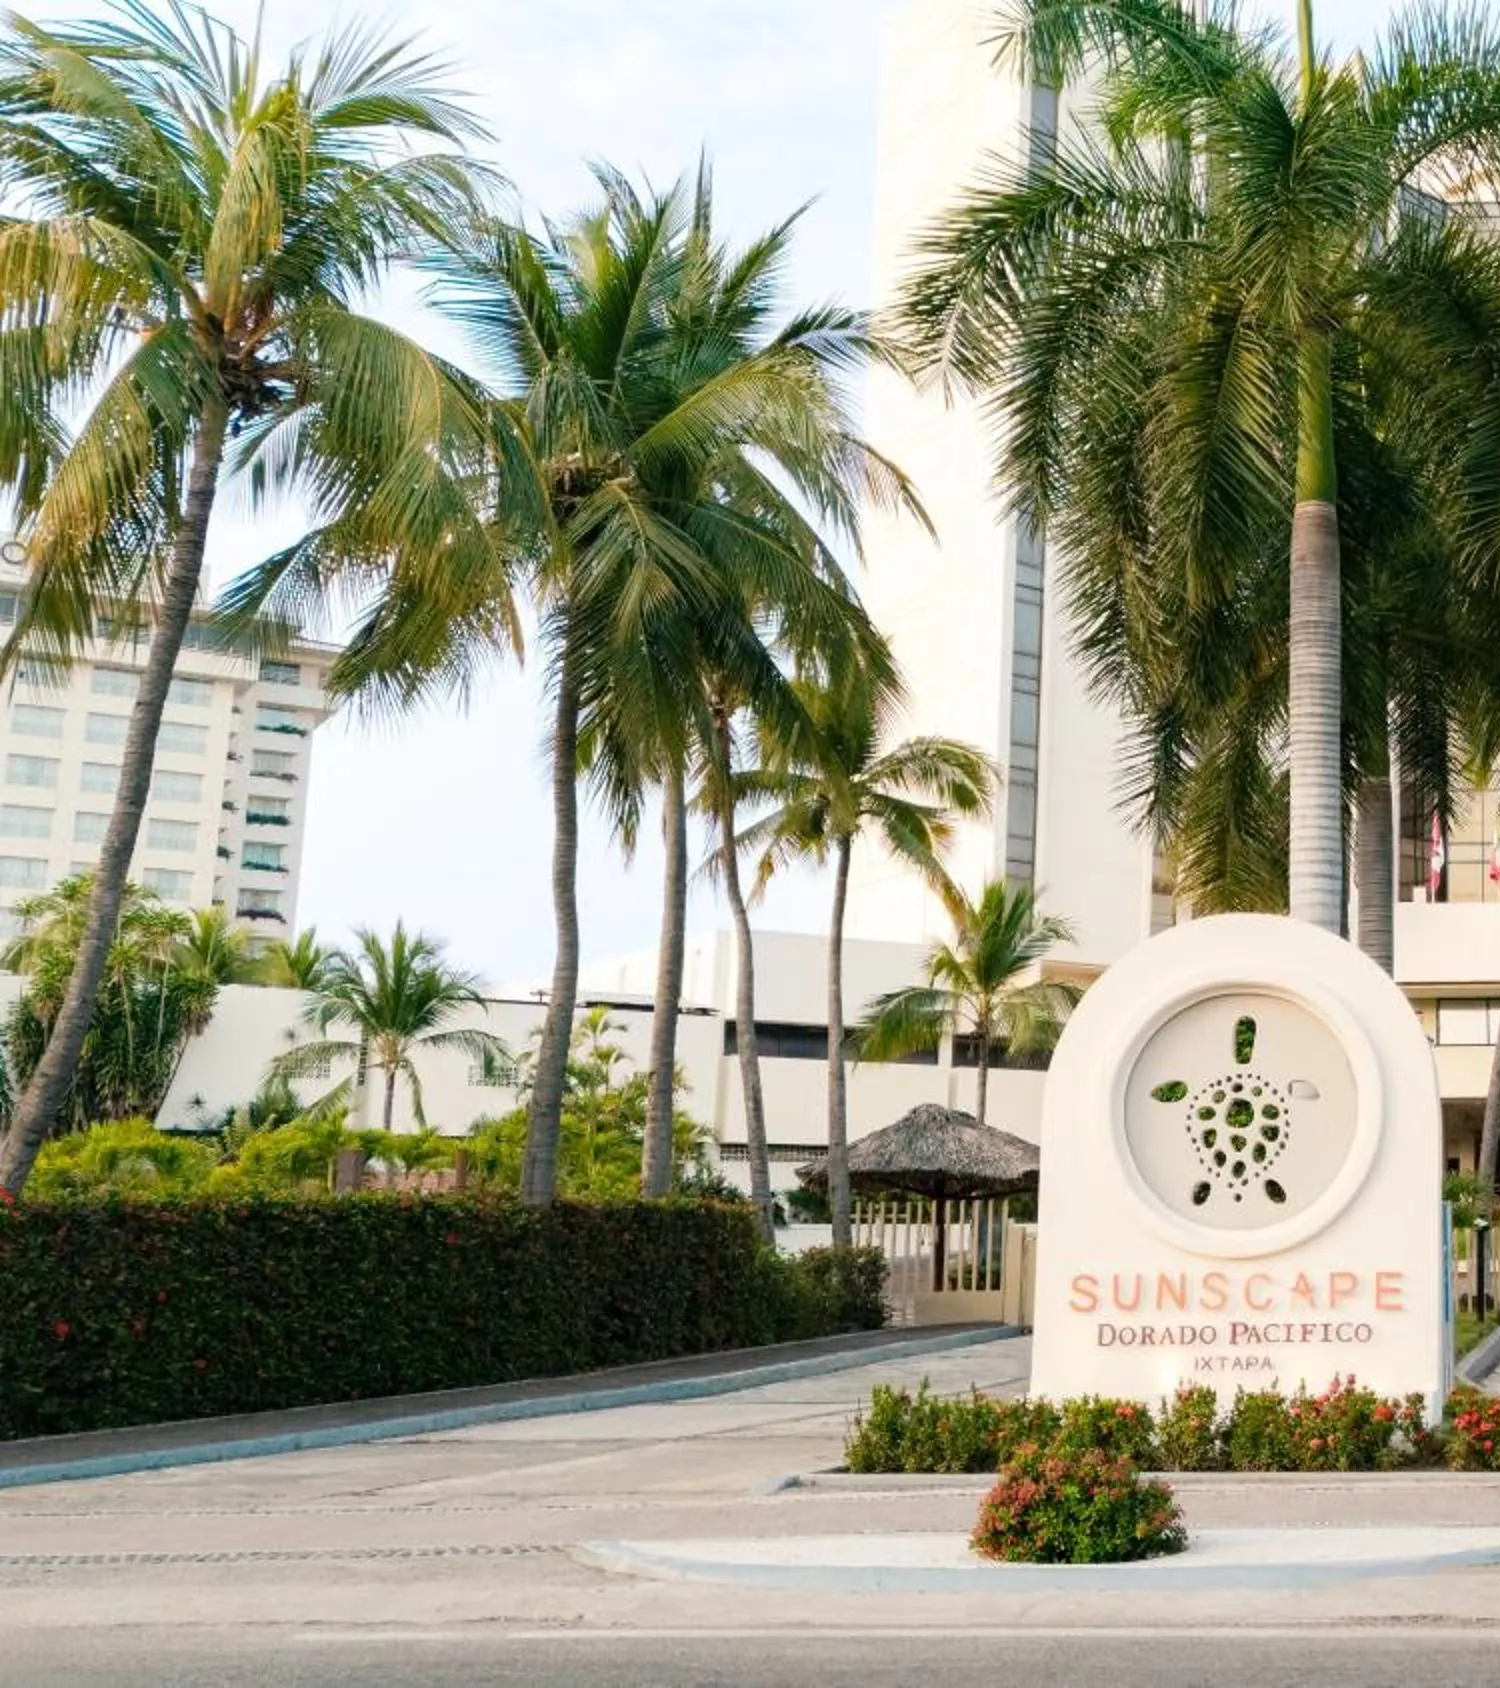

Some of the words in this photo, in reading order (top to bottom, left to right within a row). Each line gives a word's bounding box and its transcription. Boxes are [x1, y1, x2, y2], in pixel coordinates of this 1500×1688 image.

[1069, 1271, 1405, 1313] SUNSCAPE
[1097, 1322, 1218, 1348] DORADO
[1229, 1321, 1374, 1346] PACIFICO
[1194, 1355, 1274, 1373] IXTAPA
